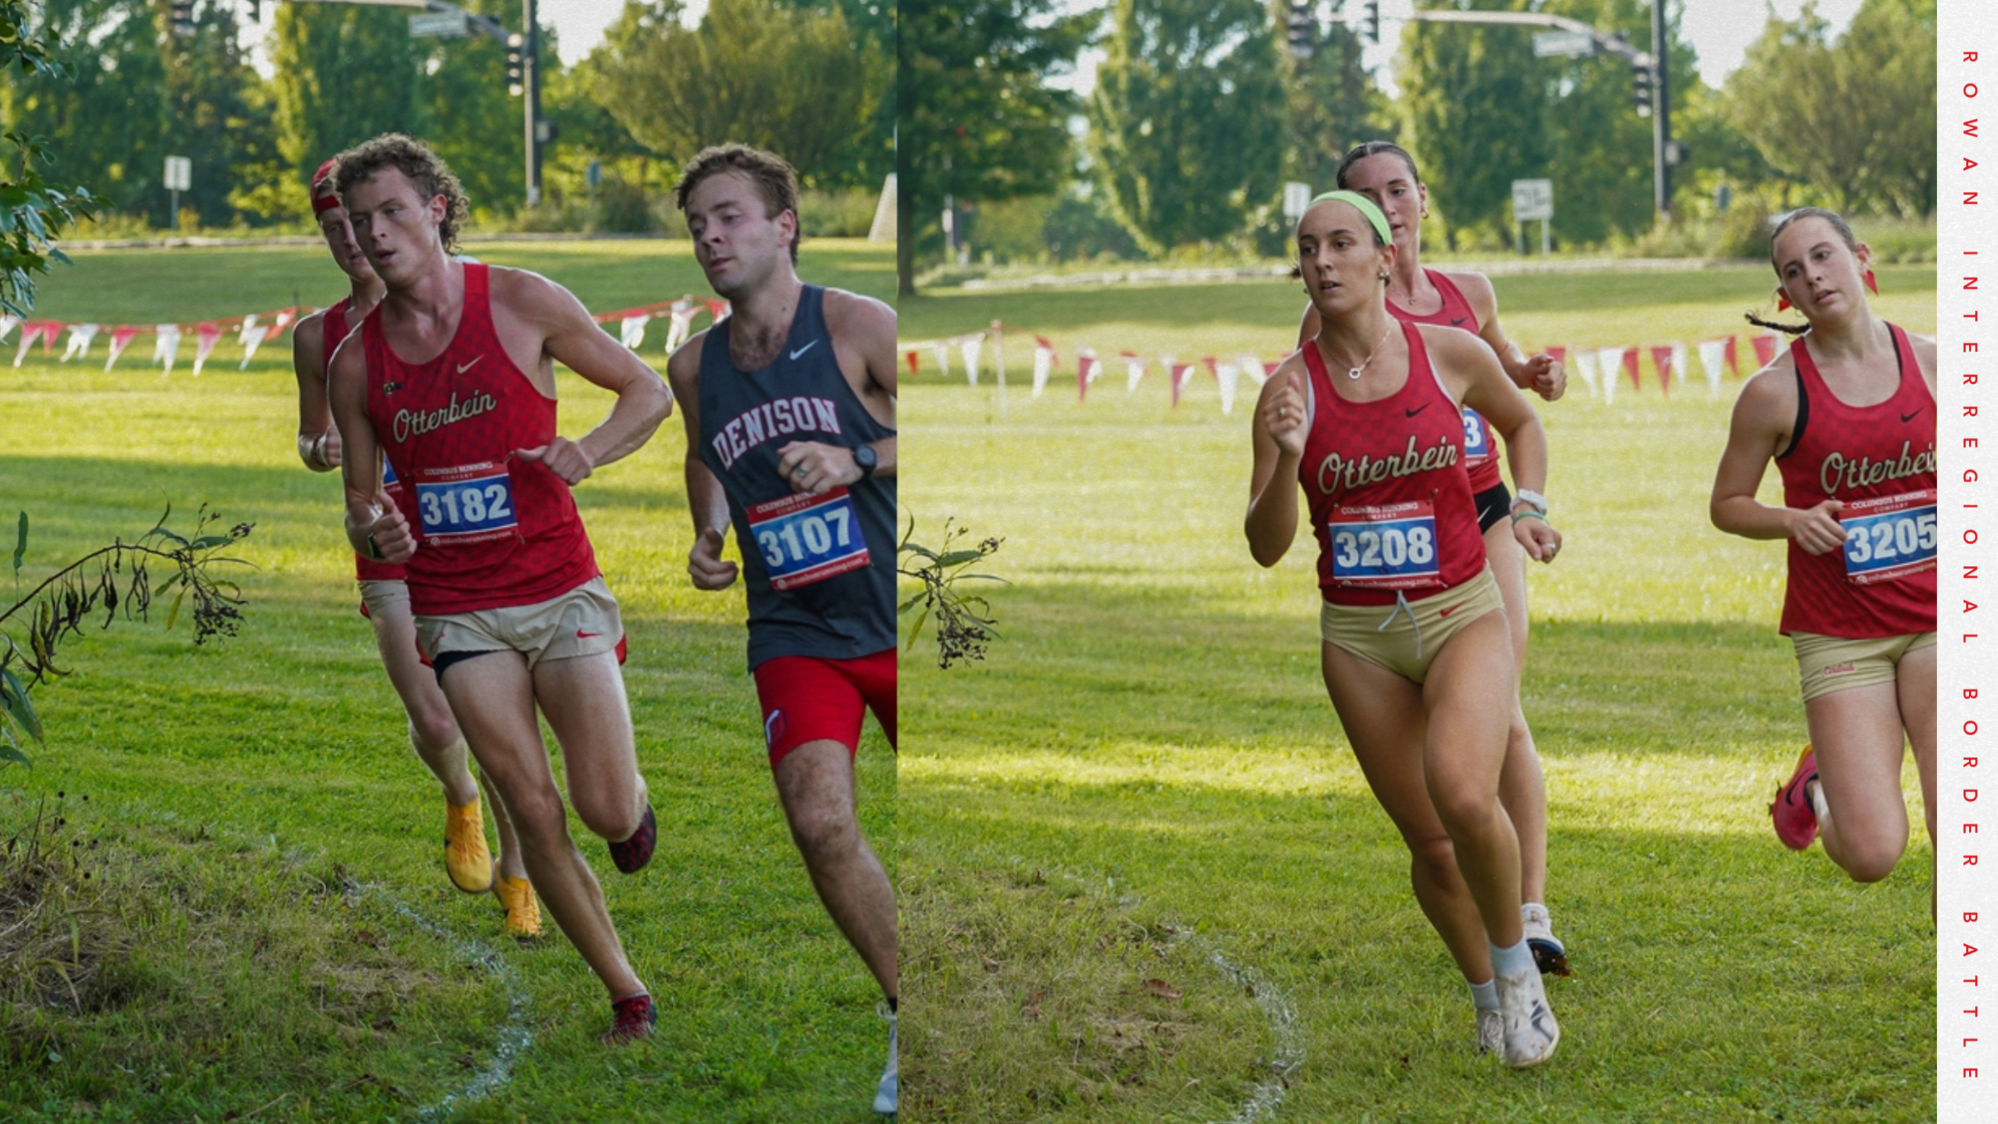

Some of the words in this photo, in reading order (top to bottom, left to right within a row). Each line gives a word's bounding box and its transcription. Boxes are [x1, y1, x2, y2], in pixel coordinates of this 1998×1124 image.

[393, 389, 497, 443] Otterbein
[712, 396, 842, 472] DENISON
[1317, 435, 1459, 495] Otterbein
[1820, 440, 1937, 495] Otterbei
[420, 484, 511, 526] 3182
[759, 506, 850, 568] 3107
[1335, 526, 1434, 568] 3208
[1847, 513, 1937, 563] 3205
